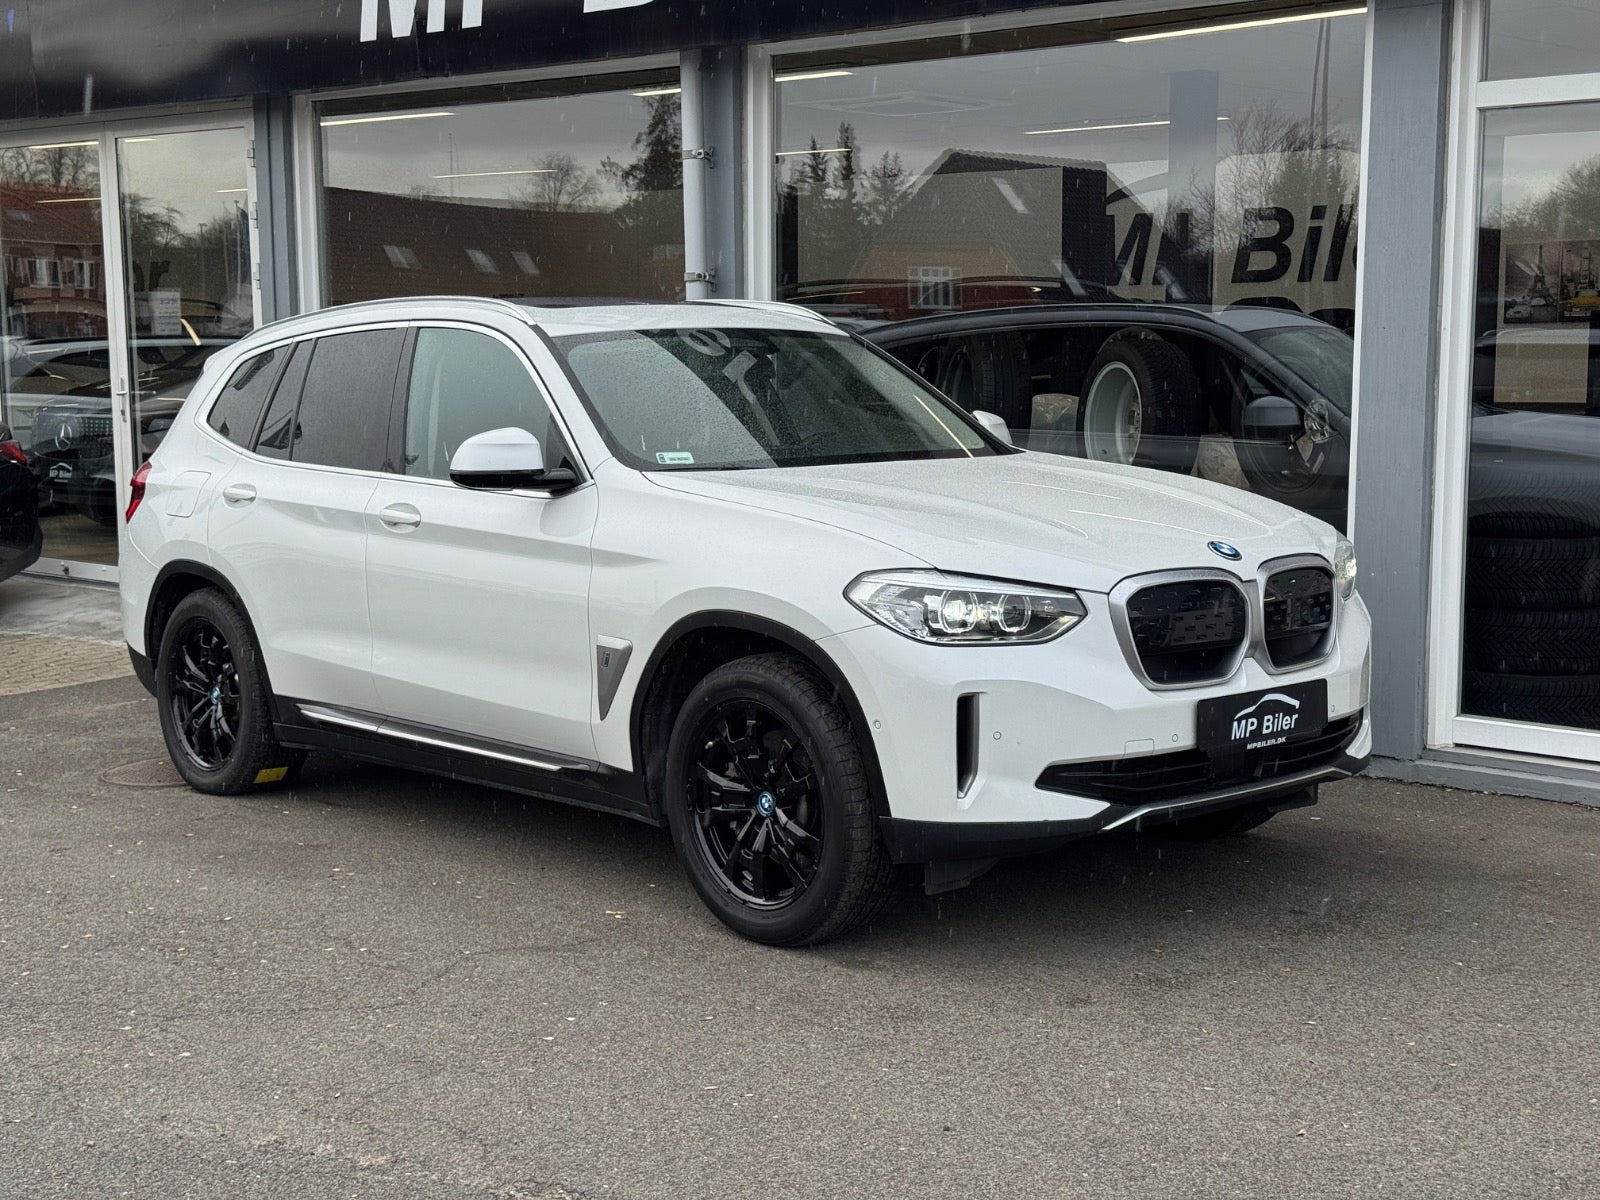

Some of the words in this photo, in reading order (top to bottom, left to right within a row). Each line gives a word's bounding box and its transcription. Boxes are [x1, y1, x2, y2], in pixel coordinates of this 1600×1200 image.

[1231, 203, 1358, 284] Bil
[1231, 717, 1258, 740] MP
[1262, 712, 1298, 735] Biler
[1246, 737, 1286, 749] MPBILER.DK
